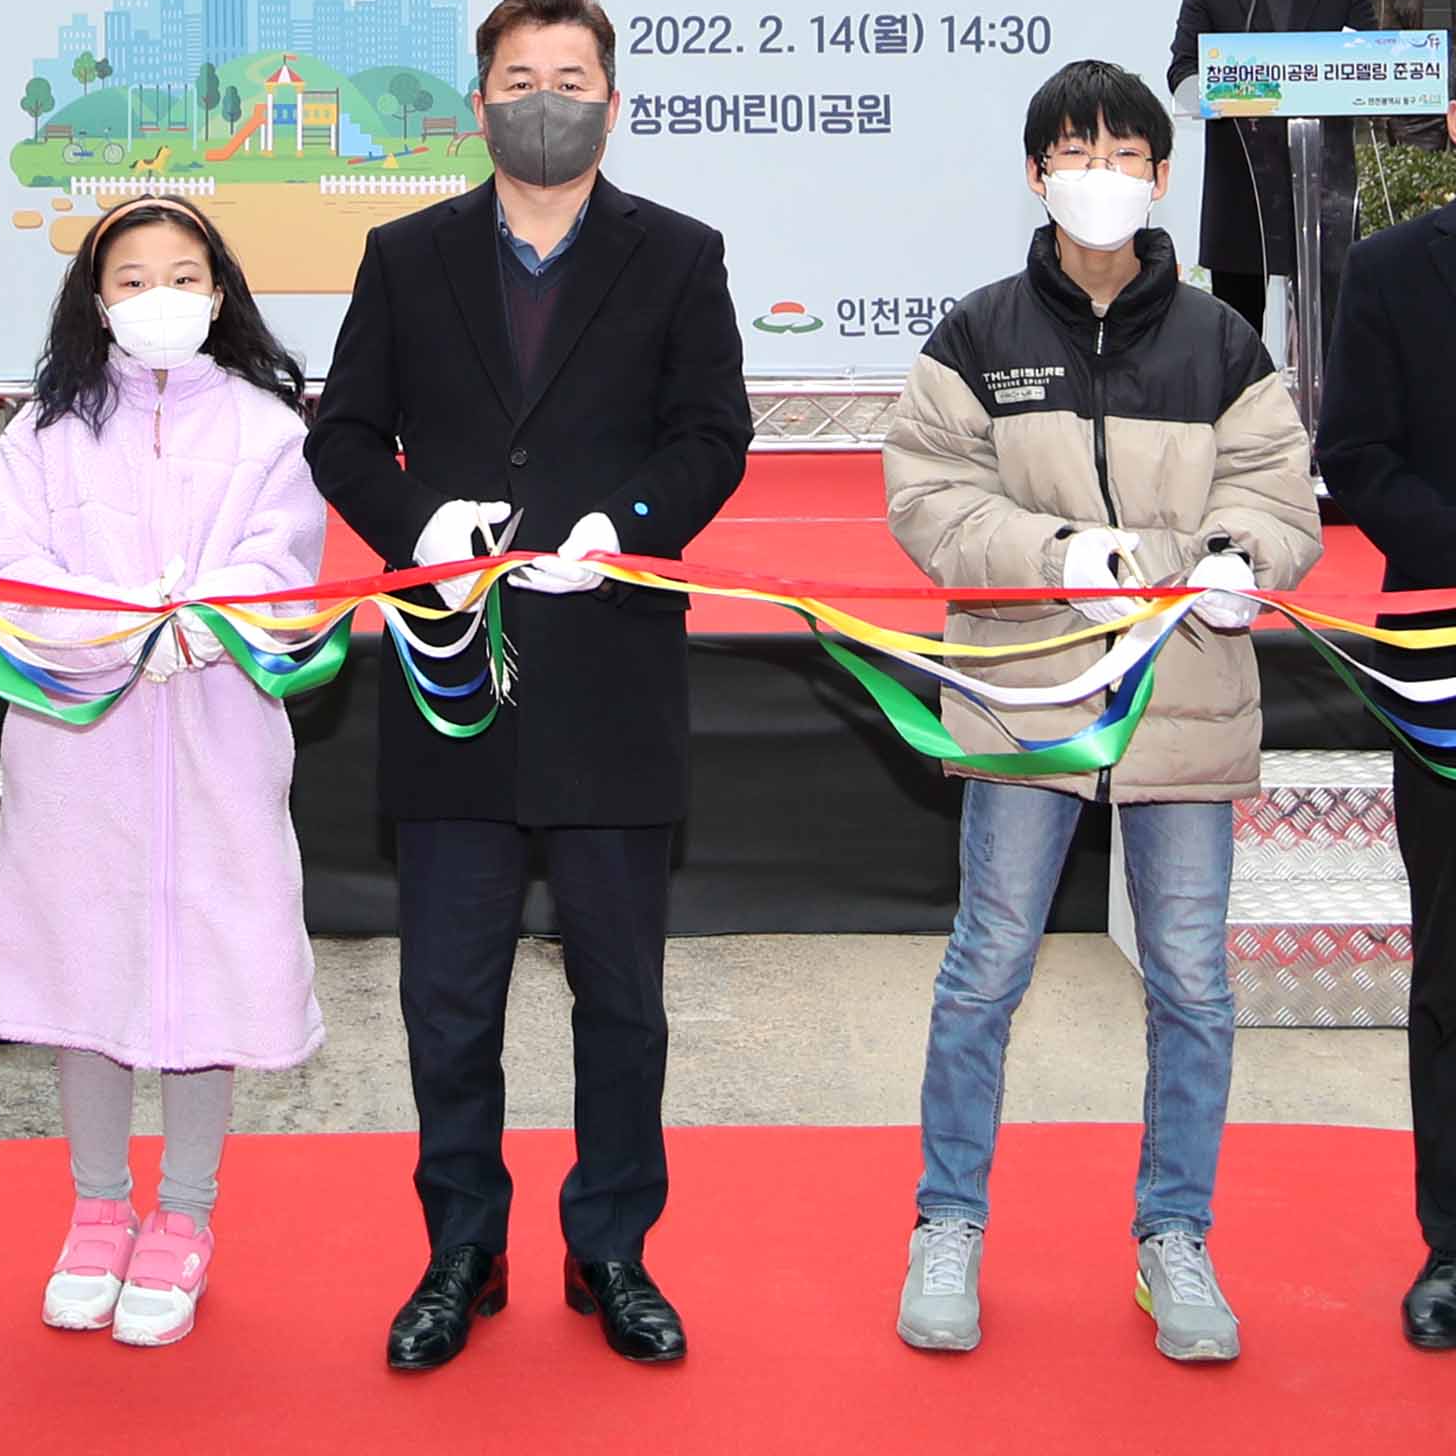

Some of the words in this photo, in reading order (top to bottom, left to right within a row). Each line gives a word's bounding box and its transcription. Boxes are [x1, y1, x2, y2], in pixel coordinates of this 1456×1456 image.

[629, 15, 744, 55] 2022.
[758, 15, 795, 55] 2.
[810, 13, 924, 55] 14(월)
[940, 15, 1052, 55] 14:30
[1206, 63, 1318, 83] 창영어린이공원
[1324, 62, 1388, 81] 리모델링
[1393, 61, 1441, 81] 준공식
[629, 93, 892, 135] 창영어린이공원
